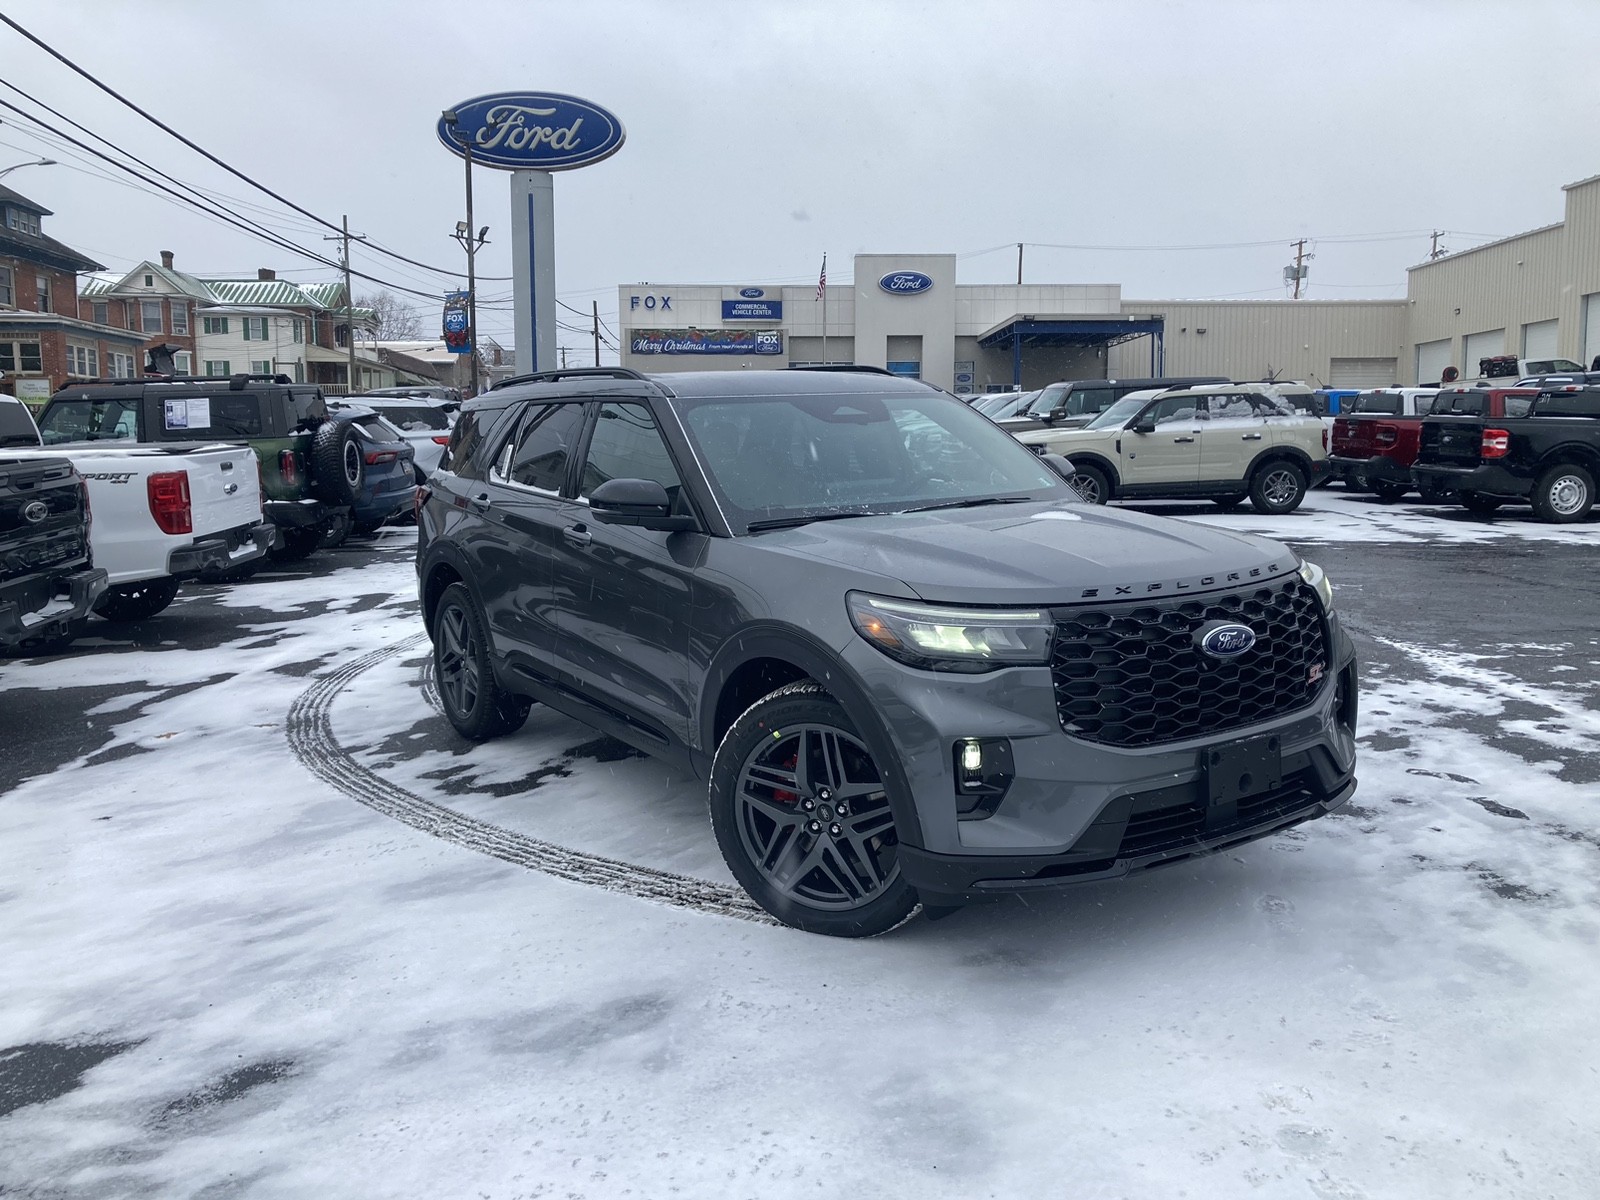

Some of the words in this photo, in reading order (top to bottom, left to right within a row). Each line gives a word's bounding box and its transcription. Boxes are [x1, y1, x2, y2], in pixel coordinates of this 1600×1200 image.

[475, 104, 584, 150] Ford
[890, 275, 922, 289] Ford
[744, 289, 760, 297] Ford
[630, 296, 671, 309] FOX
[446, 314, 464, 323] FOX
[632, 339, 663, 353] Merry
[664, 339, 706, 352] Christmas
[757, 335, 778, 344] FOX
[79, 472, 139, 481] PORT
[1081, 563, 1280, 599] EXPLORER
[1217, 631, 1247, 652] Ford
